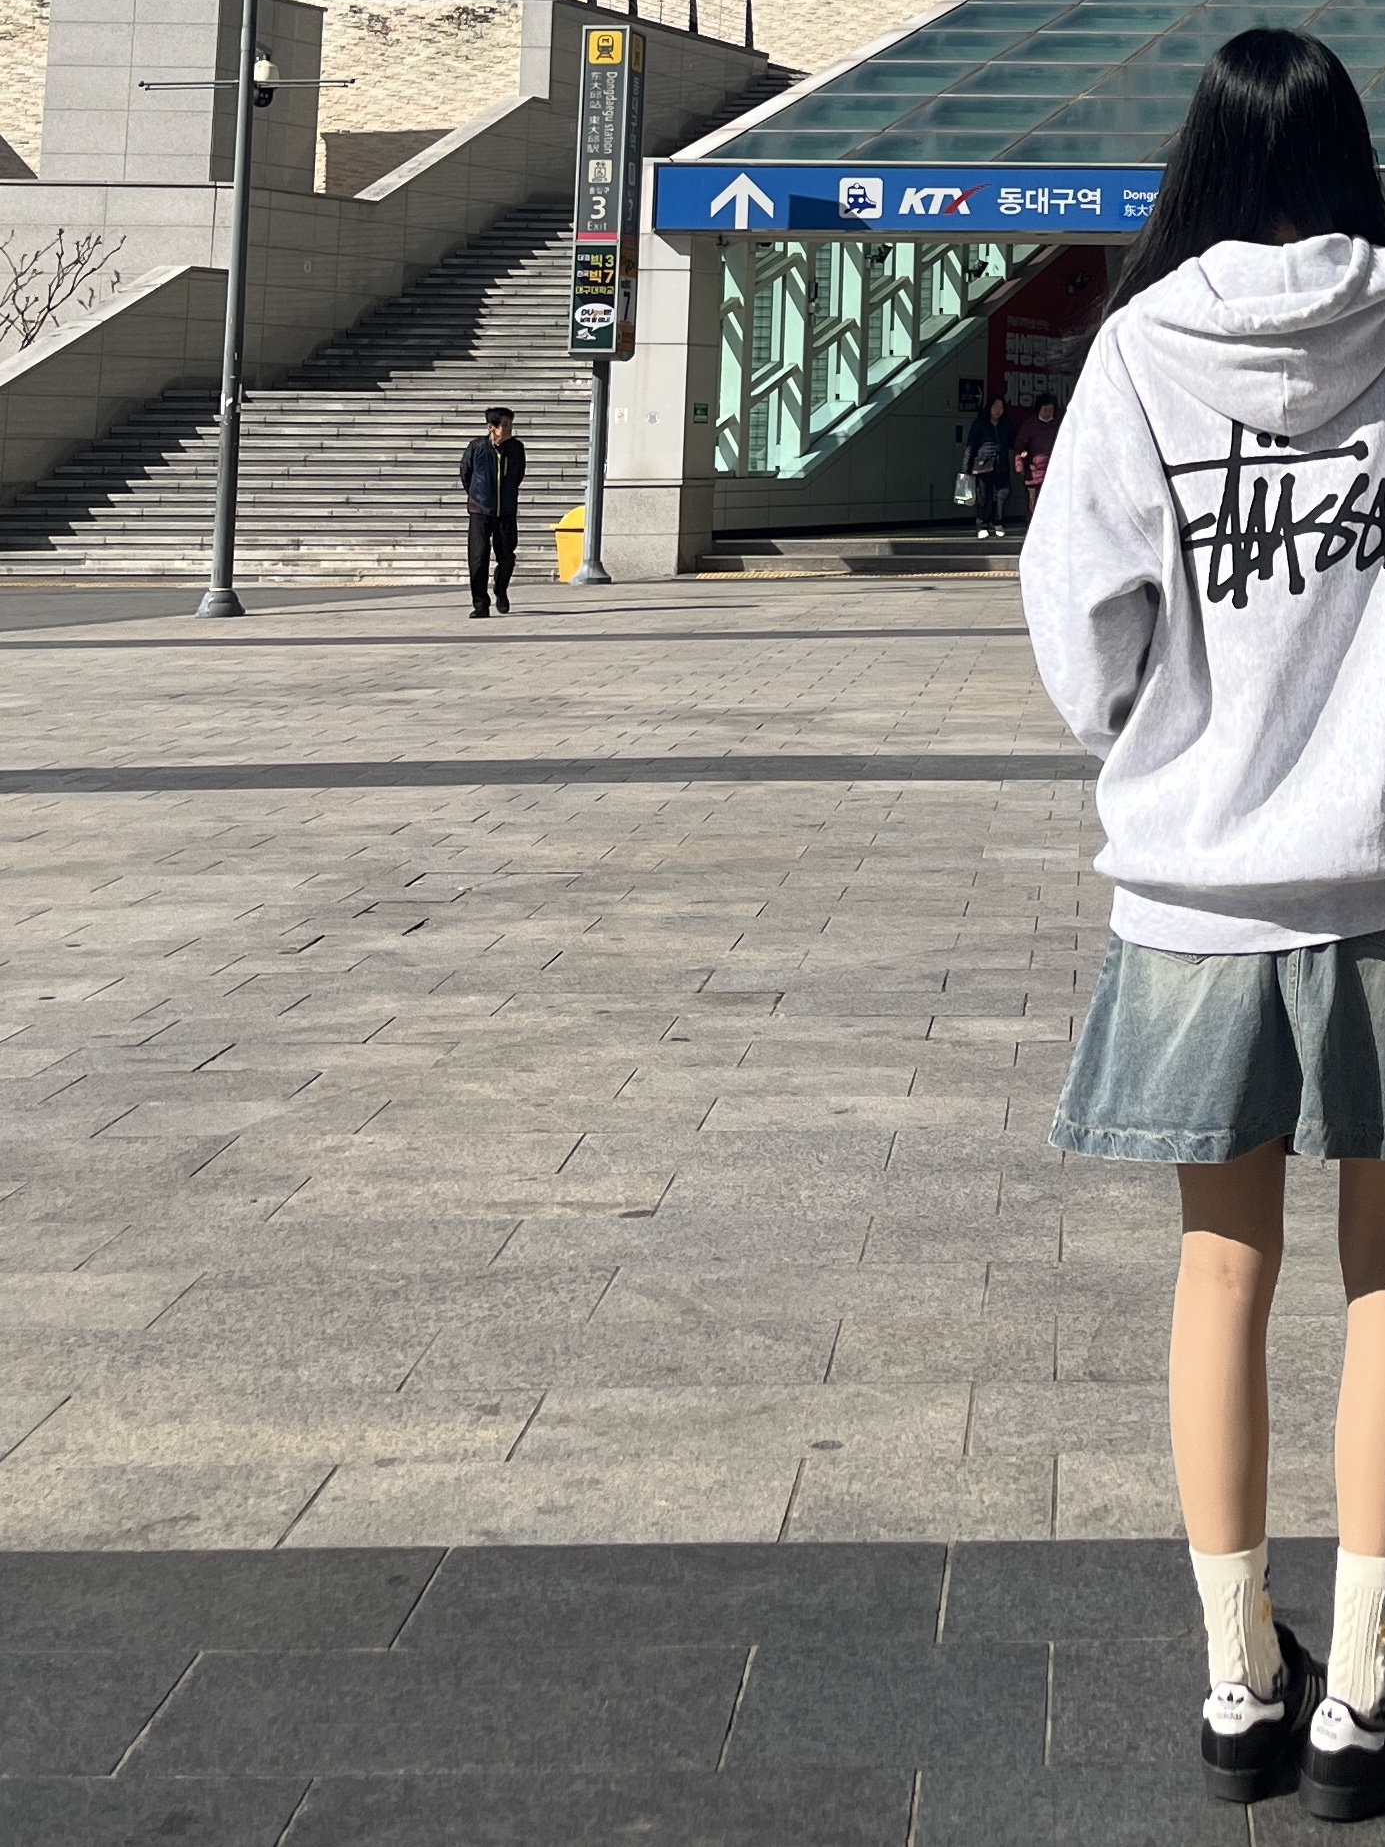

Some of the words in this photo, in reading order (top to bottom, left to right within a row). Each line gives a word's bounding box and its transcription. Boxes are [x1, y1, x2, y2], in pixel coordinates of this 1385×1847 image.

[601, 71, 618, 122] Dongdaegu
[590, 196, 607, 220] 3
[898, 184, 986, 215] KTX
[997, 187, 1101, 216] 동대구역
[586, 220, 608, 232] Exit
